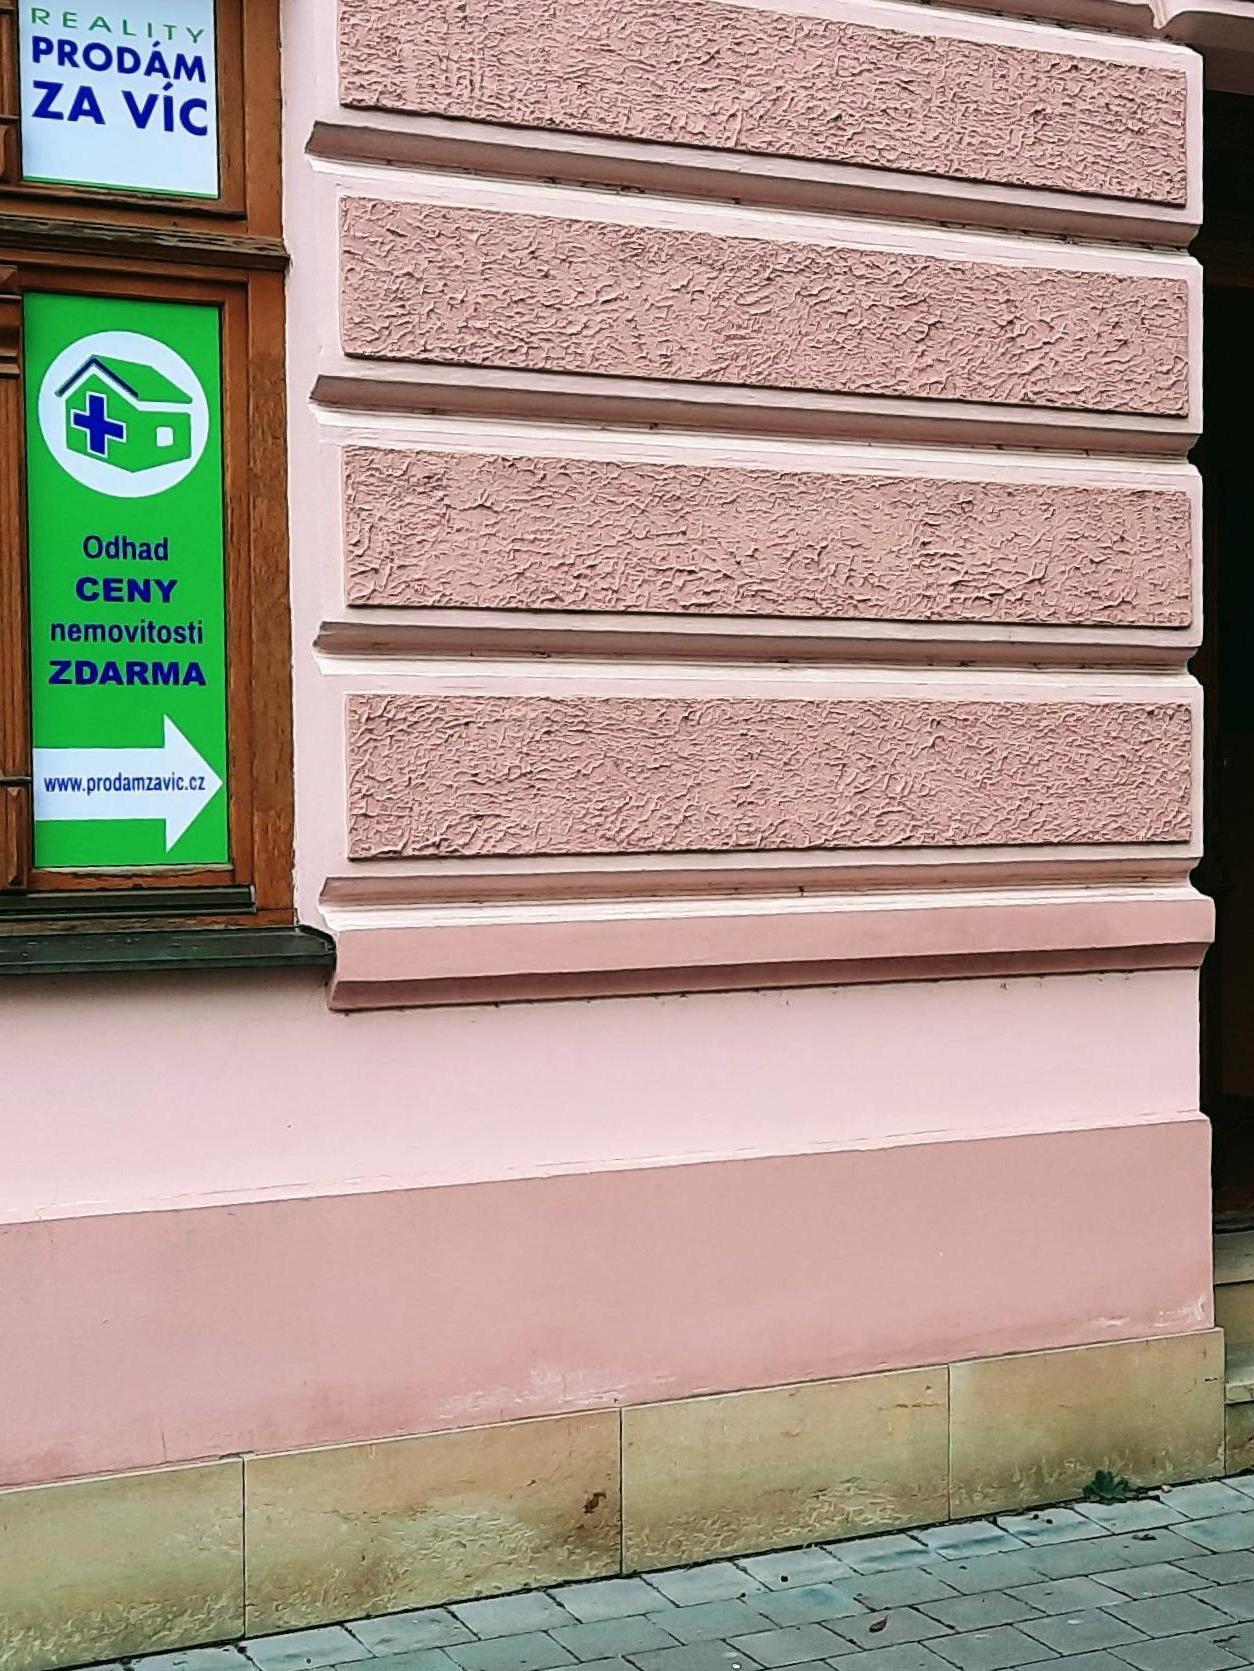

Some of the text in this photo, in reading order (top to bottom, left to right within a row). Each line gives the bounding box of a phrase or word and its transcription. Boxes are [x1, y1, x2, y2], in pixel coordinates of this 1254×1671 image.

[31, 7, 204, 44] REALITY
[32, 35, 206, 83] PRODÁM
[32, 80, 208, 137] ZA VÍC
[82, 535, 169, 561] Odhad
[75, 577, 178, 603] CENY
[51, 618, 203, 644] nemovitosti
[48, 660, 207, 686] ZDARMA
[44, 772, 206, 798] www.prodamzavic.cz
